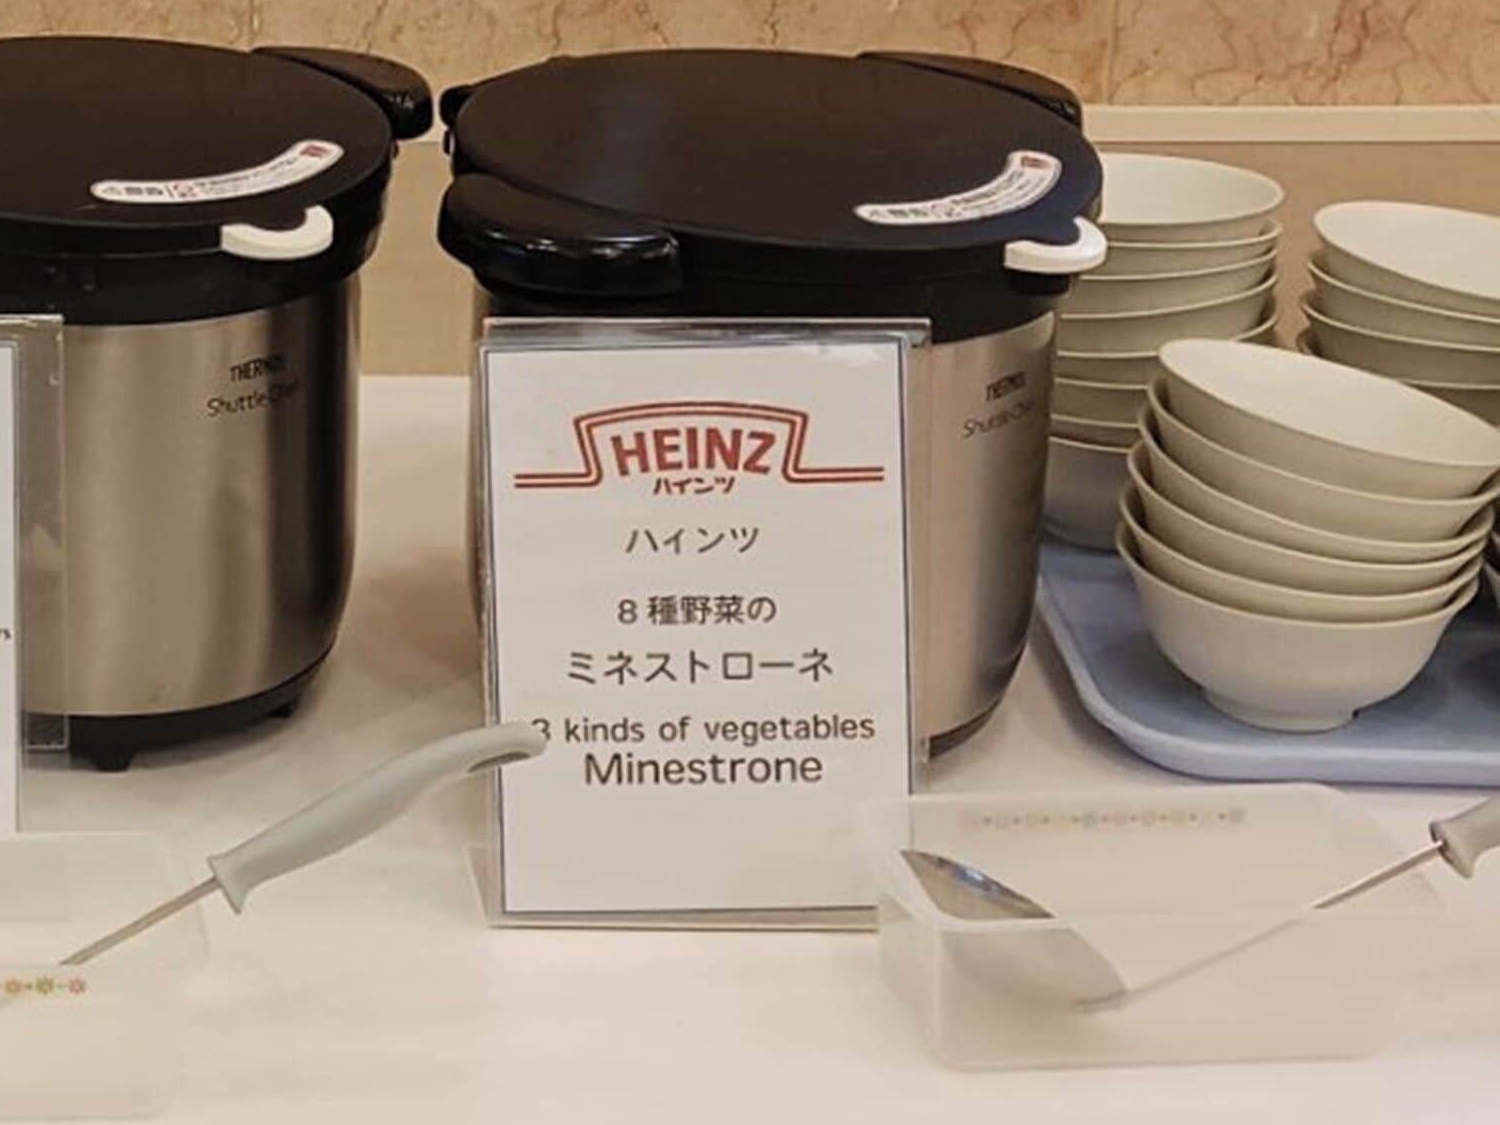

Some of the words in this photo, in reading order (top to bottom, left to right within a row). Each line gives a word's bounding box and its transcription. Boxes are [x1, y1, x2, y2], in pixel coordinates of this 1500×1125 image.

[610, 426, 776, 476] HEINZ
[653, 477, 735, 495] ハインツ
[625, 528, 759, 554] ハインツ
[567, 648, 834, 685] ミネストローネ
[564, 717, 645, 742] kinds
[658, 715, 692, 742] of
[704, 714, 876, 747] vegetables
[584, 752, 823, 785] Minestrone
